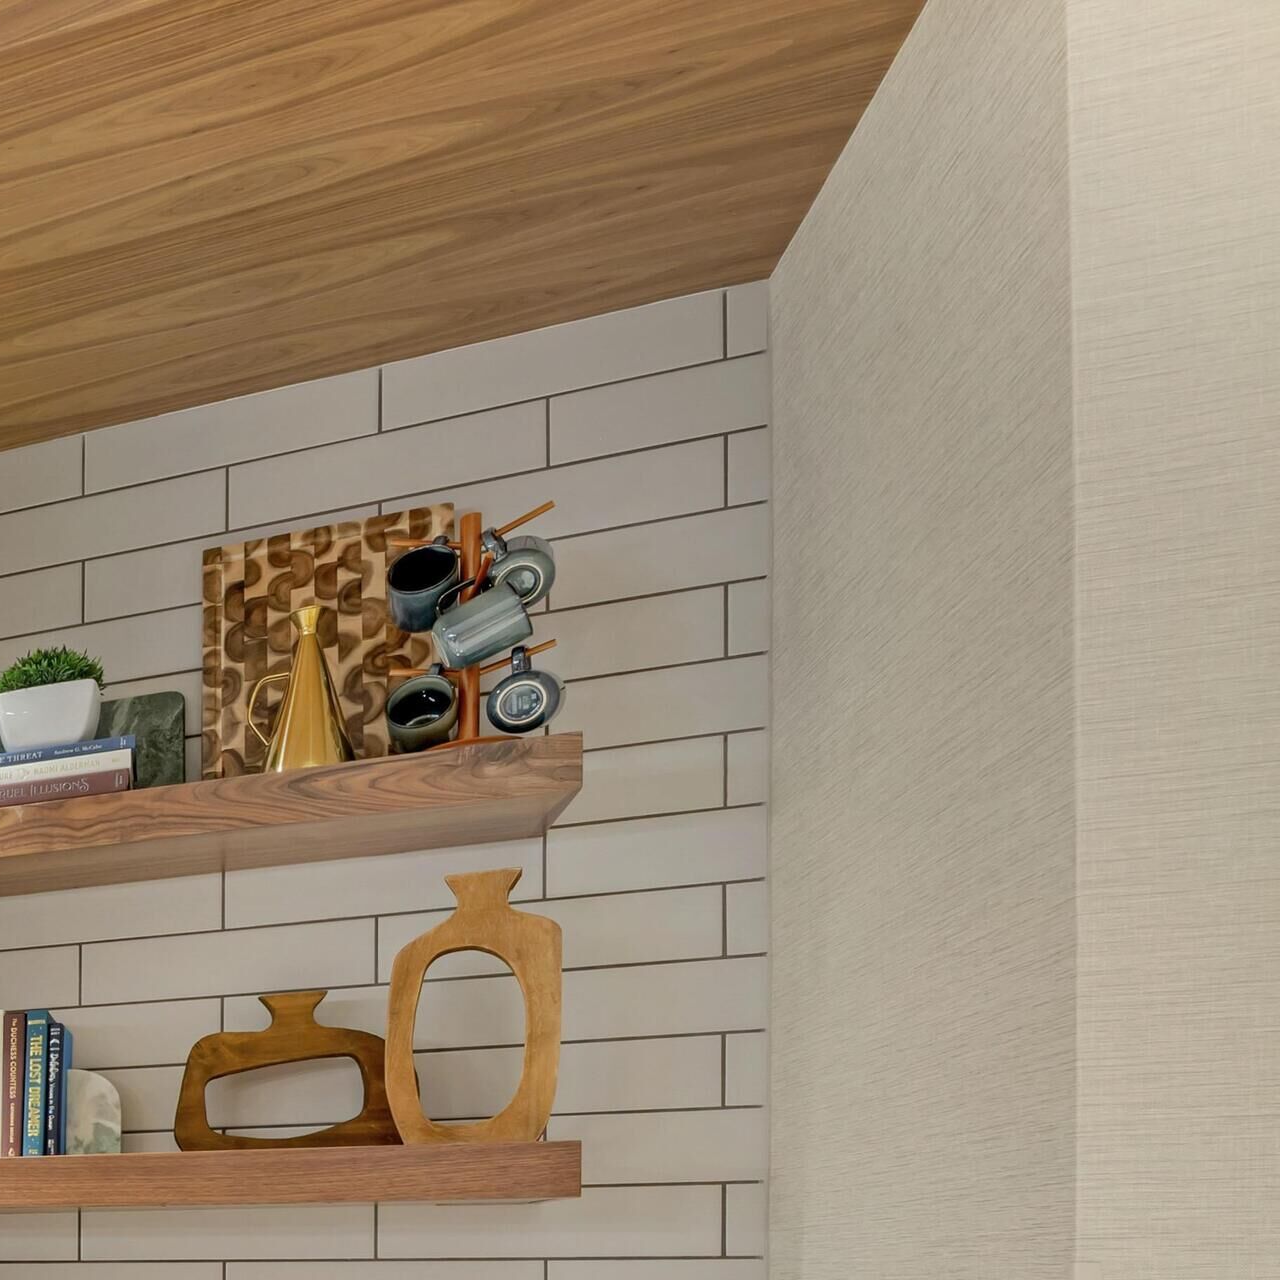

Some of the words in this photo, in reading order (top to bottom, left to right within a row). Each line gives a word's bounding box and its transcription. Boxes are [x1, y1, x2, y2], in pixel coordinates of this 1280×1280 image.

[7, 751, 42, 763] THREAT
[30, 778, 89, 798] ILLUSIONS
[30, 1035, 44, 1056] THE
[9, 1061, 17, 1099] COUNTESS
[29, 1058, 43, 1085] LOST
[27, 1087, 41, 1137] DREAMER
